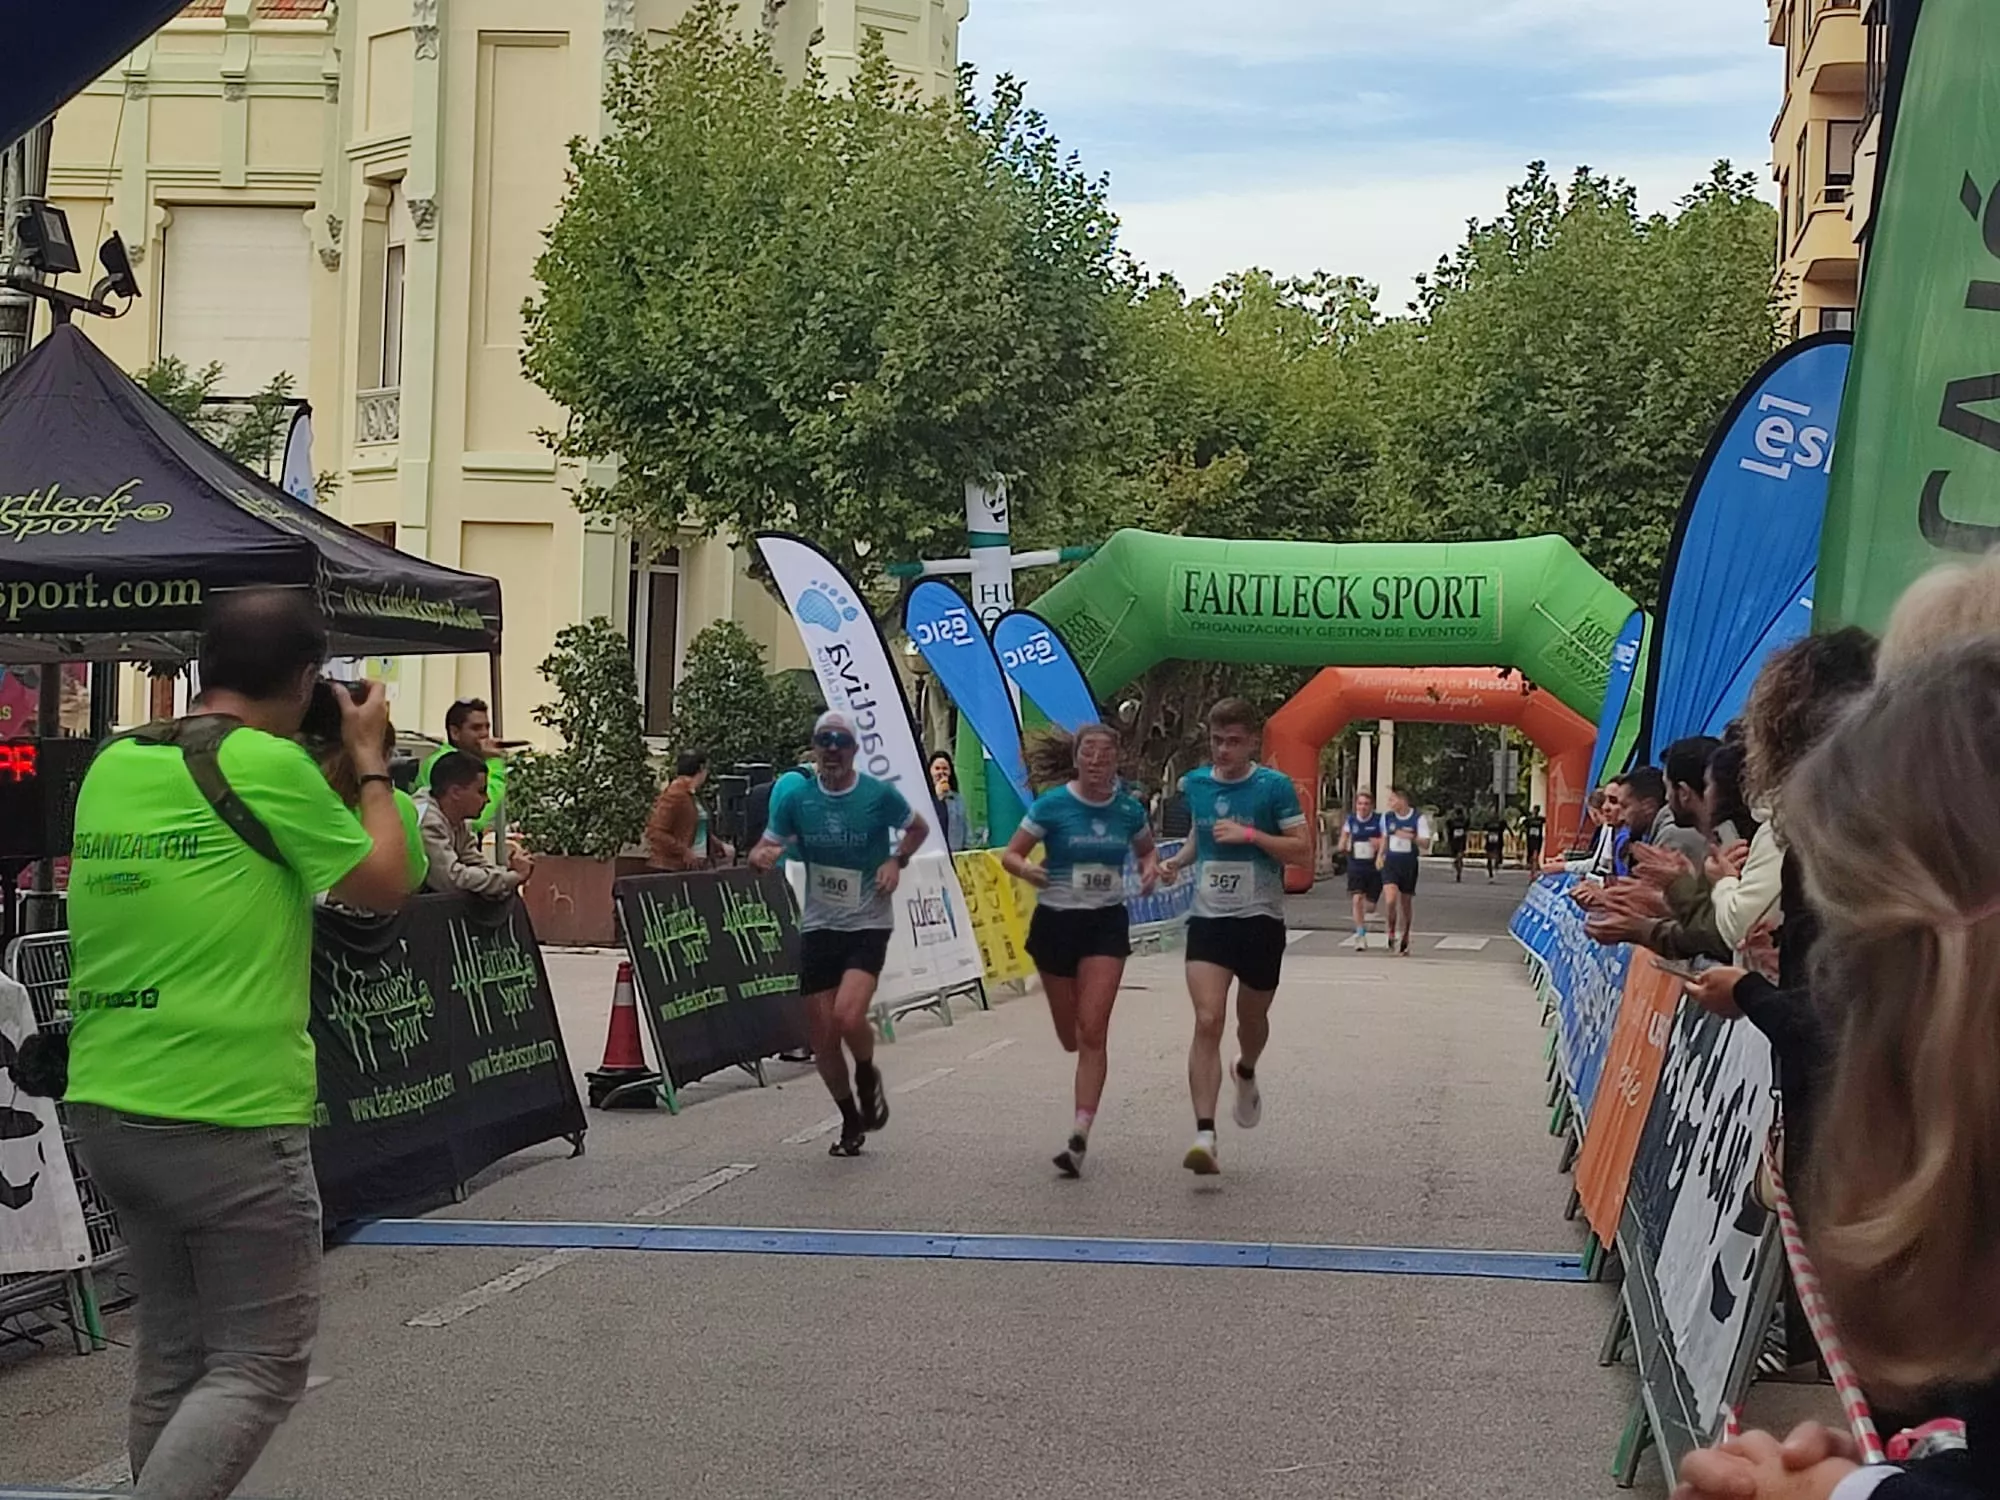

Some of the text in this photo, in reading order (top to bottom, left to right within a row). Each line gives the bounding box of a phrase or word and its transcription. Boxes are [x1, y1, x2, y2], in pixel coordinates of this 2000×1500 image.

[0, 507, 122, 543] Sport
[1182, 570, 1488, 620] FARTLECK SPORT
[1302, 626, 1313, 637] Y
[1384, 627, 1406, 638] DE
[1408, 627, 1478, 640] EVENTOS
[1468, 677, 1519, 692] Huesca
[1210, 873, 1241, 890] 367
